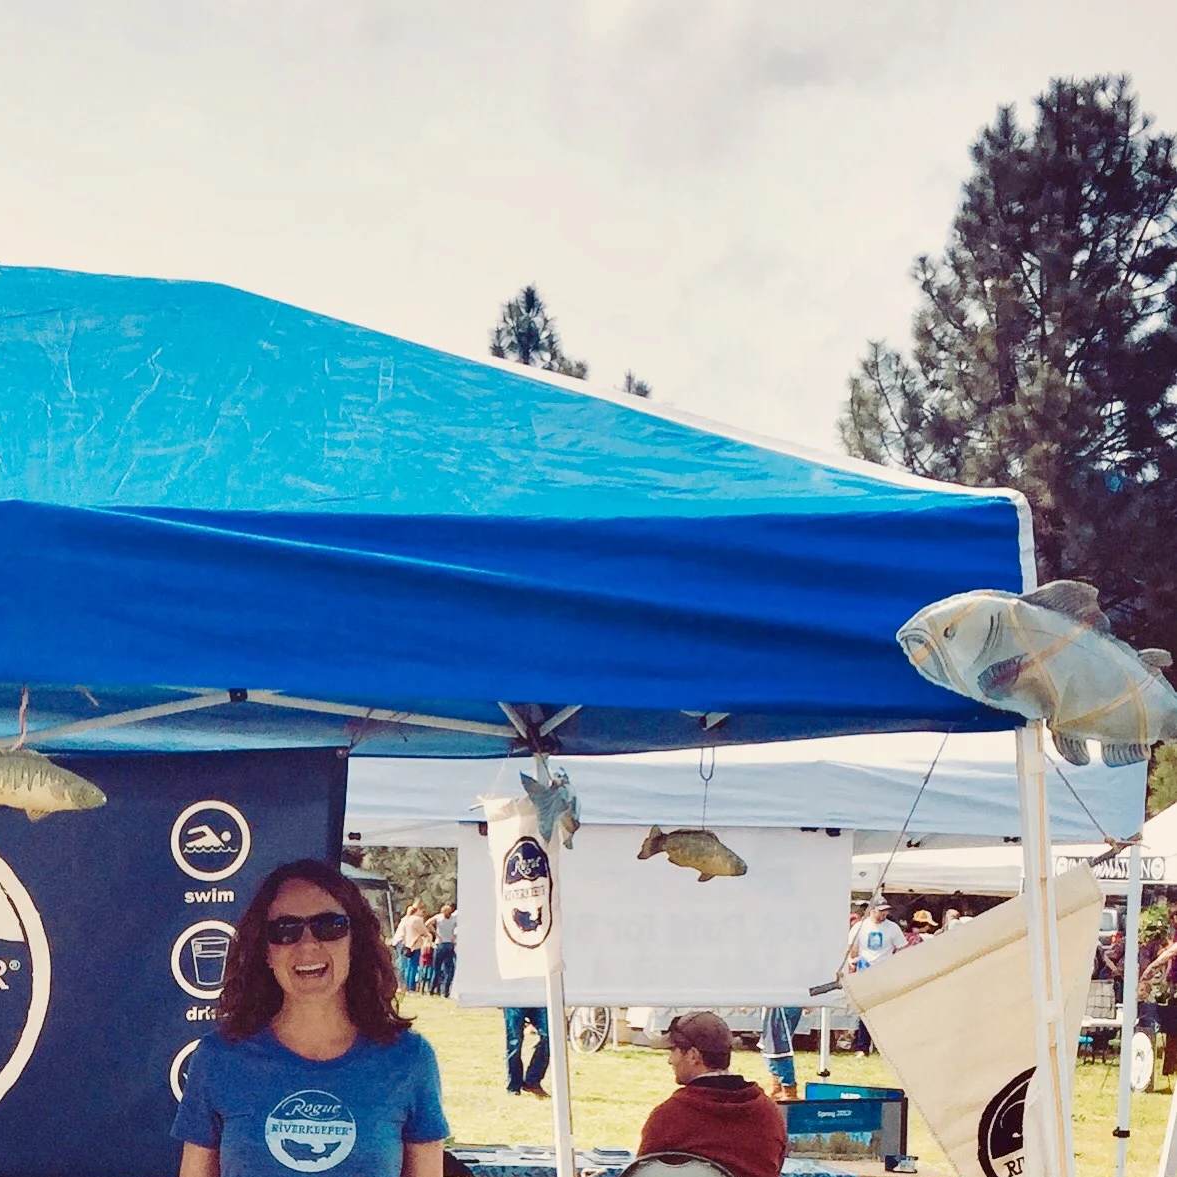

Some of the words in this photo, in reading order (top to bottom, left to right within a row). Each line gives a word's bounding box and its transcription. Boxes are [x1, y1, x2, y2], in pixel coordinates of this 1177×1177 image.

[184, 888, 235, 904] swim
[186, 1005, 217, 1021] dri
[282, 1098, 341, 1120] Rogue
